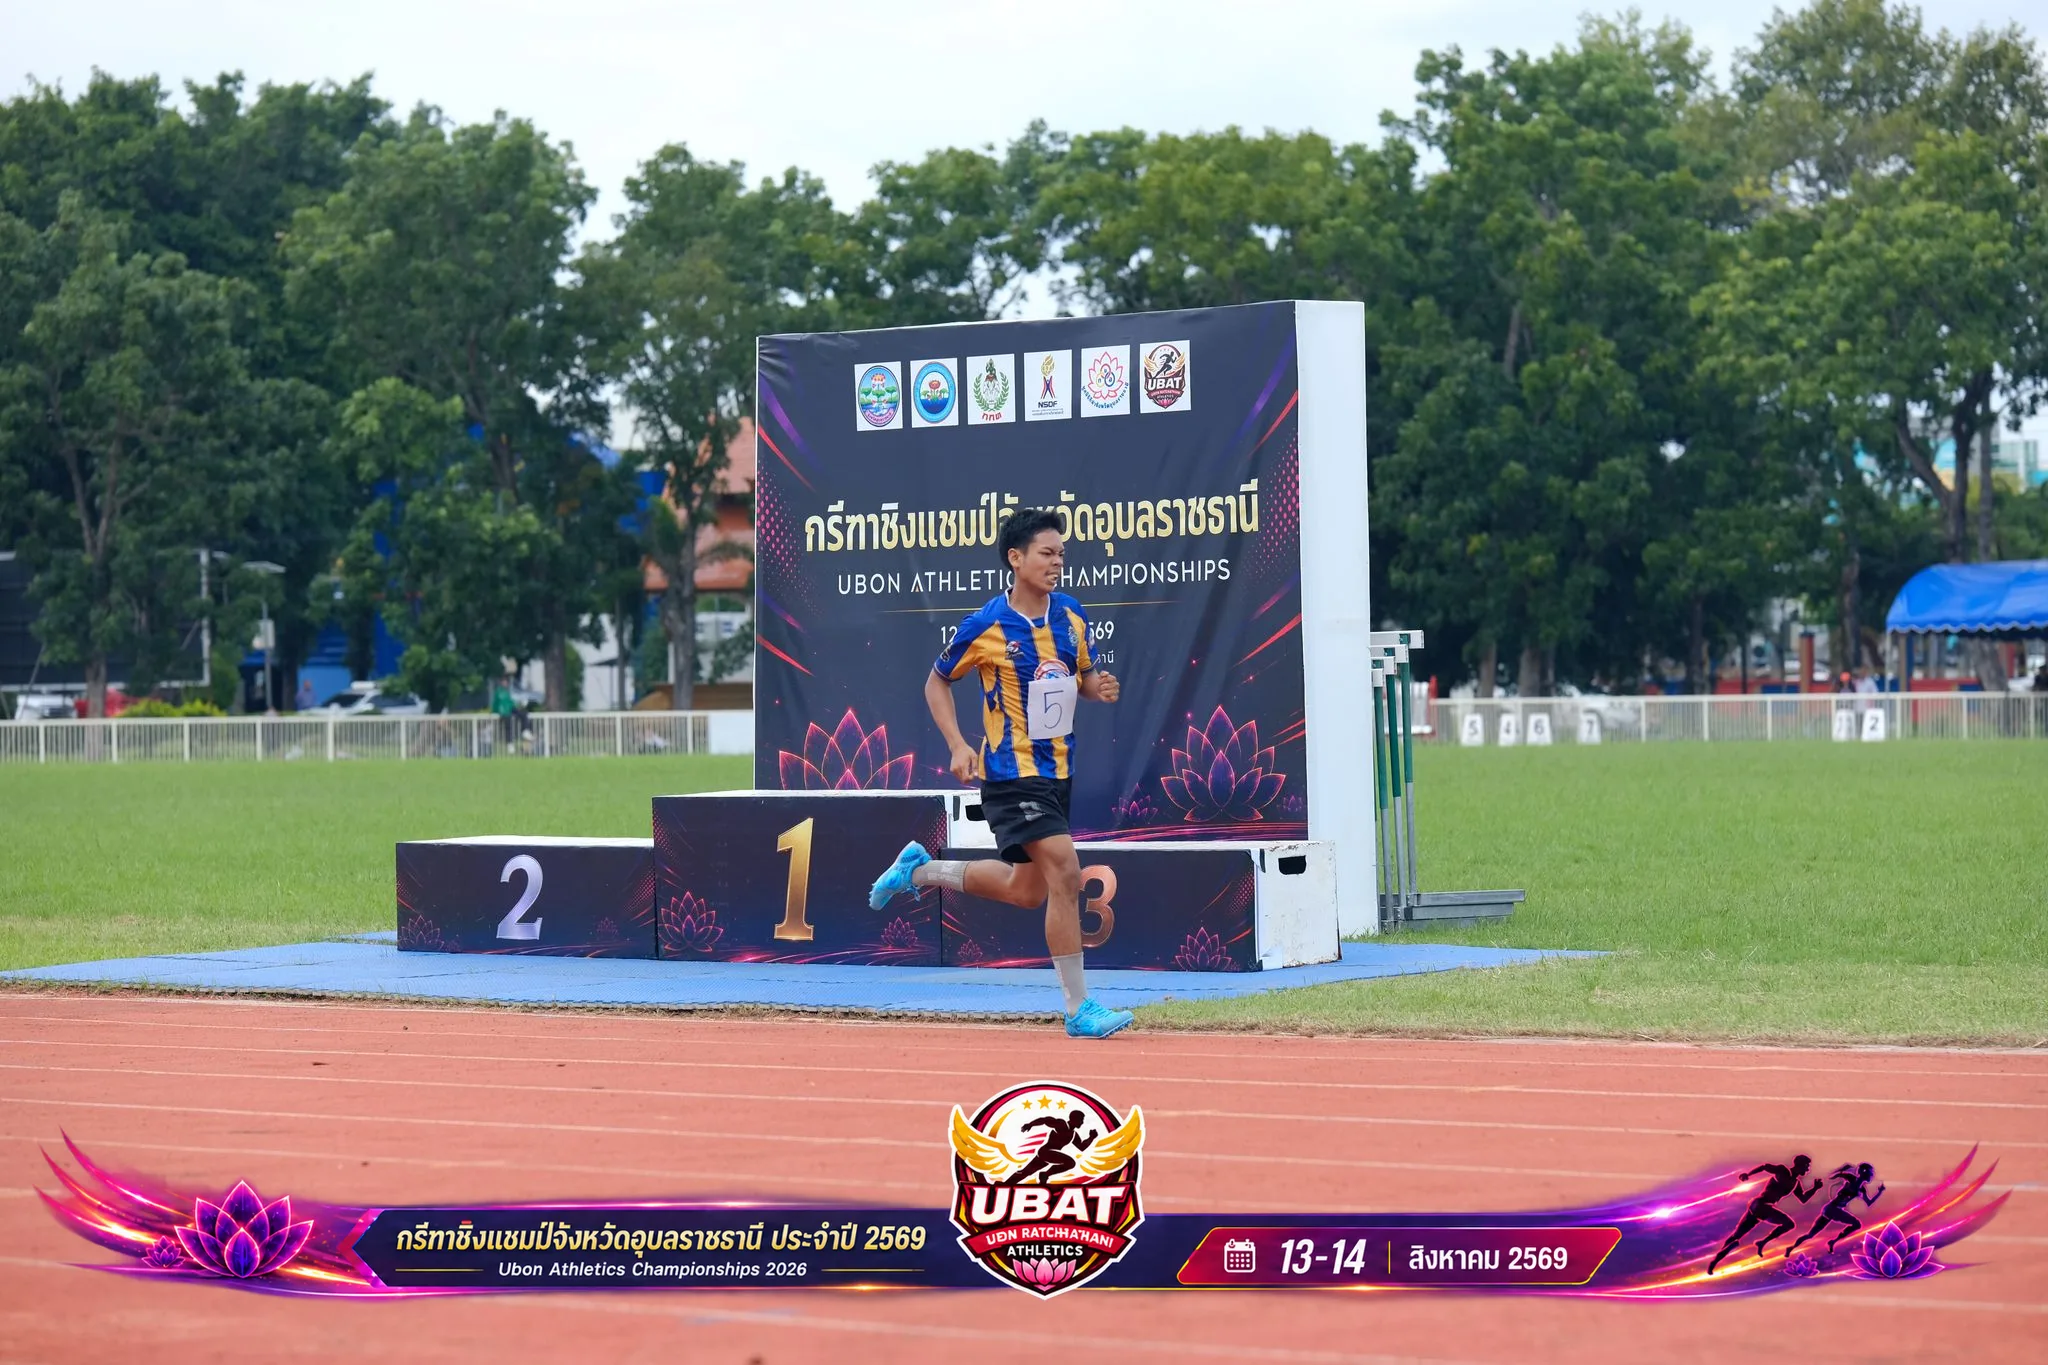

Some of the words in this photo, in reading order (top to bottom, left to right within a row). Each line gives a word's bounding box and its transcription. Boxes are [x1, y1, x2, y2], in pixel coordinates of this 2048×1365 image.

[1147, 376, 1182, 391] UBAT
[1037, 400, 1058, 409] NSDF
[838, 573, 900, 595] UBON
[911, 569, 1015, 593] ATHLETIC
[1052, 558, 1231, 588] HAMPIONSHIPS
[1088, 620, 1115, 640] 569
[1043, 689, 1065, 729] 5
[1468, 719, 1479, 736] 5
[1533, 718, 1545, 735] 6
[1585, 719, 1594, 735] 7
[1869, 715, 1879, 732] 2
[773, 817, 815, 941] 1
[496, 854, 543, 941] 2
[1079, 864, 1117, 948] 3
